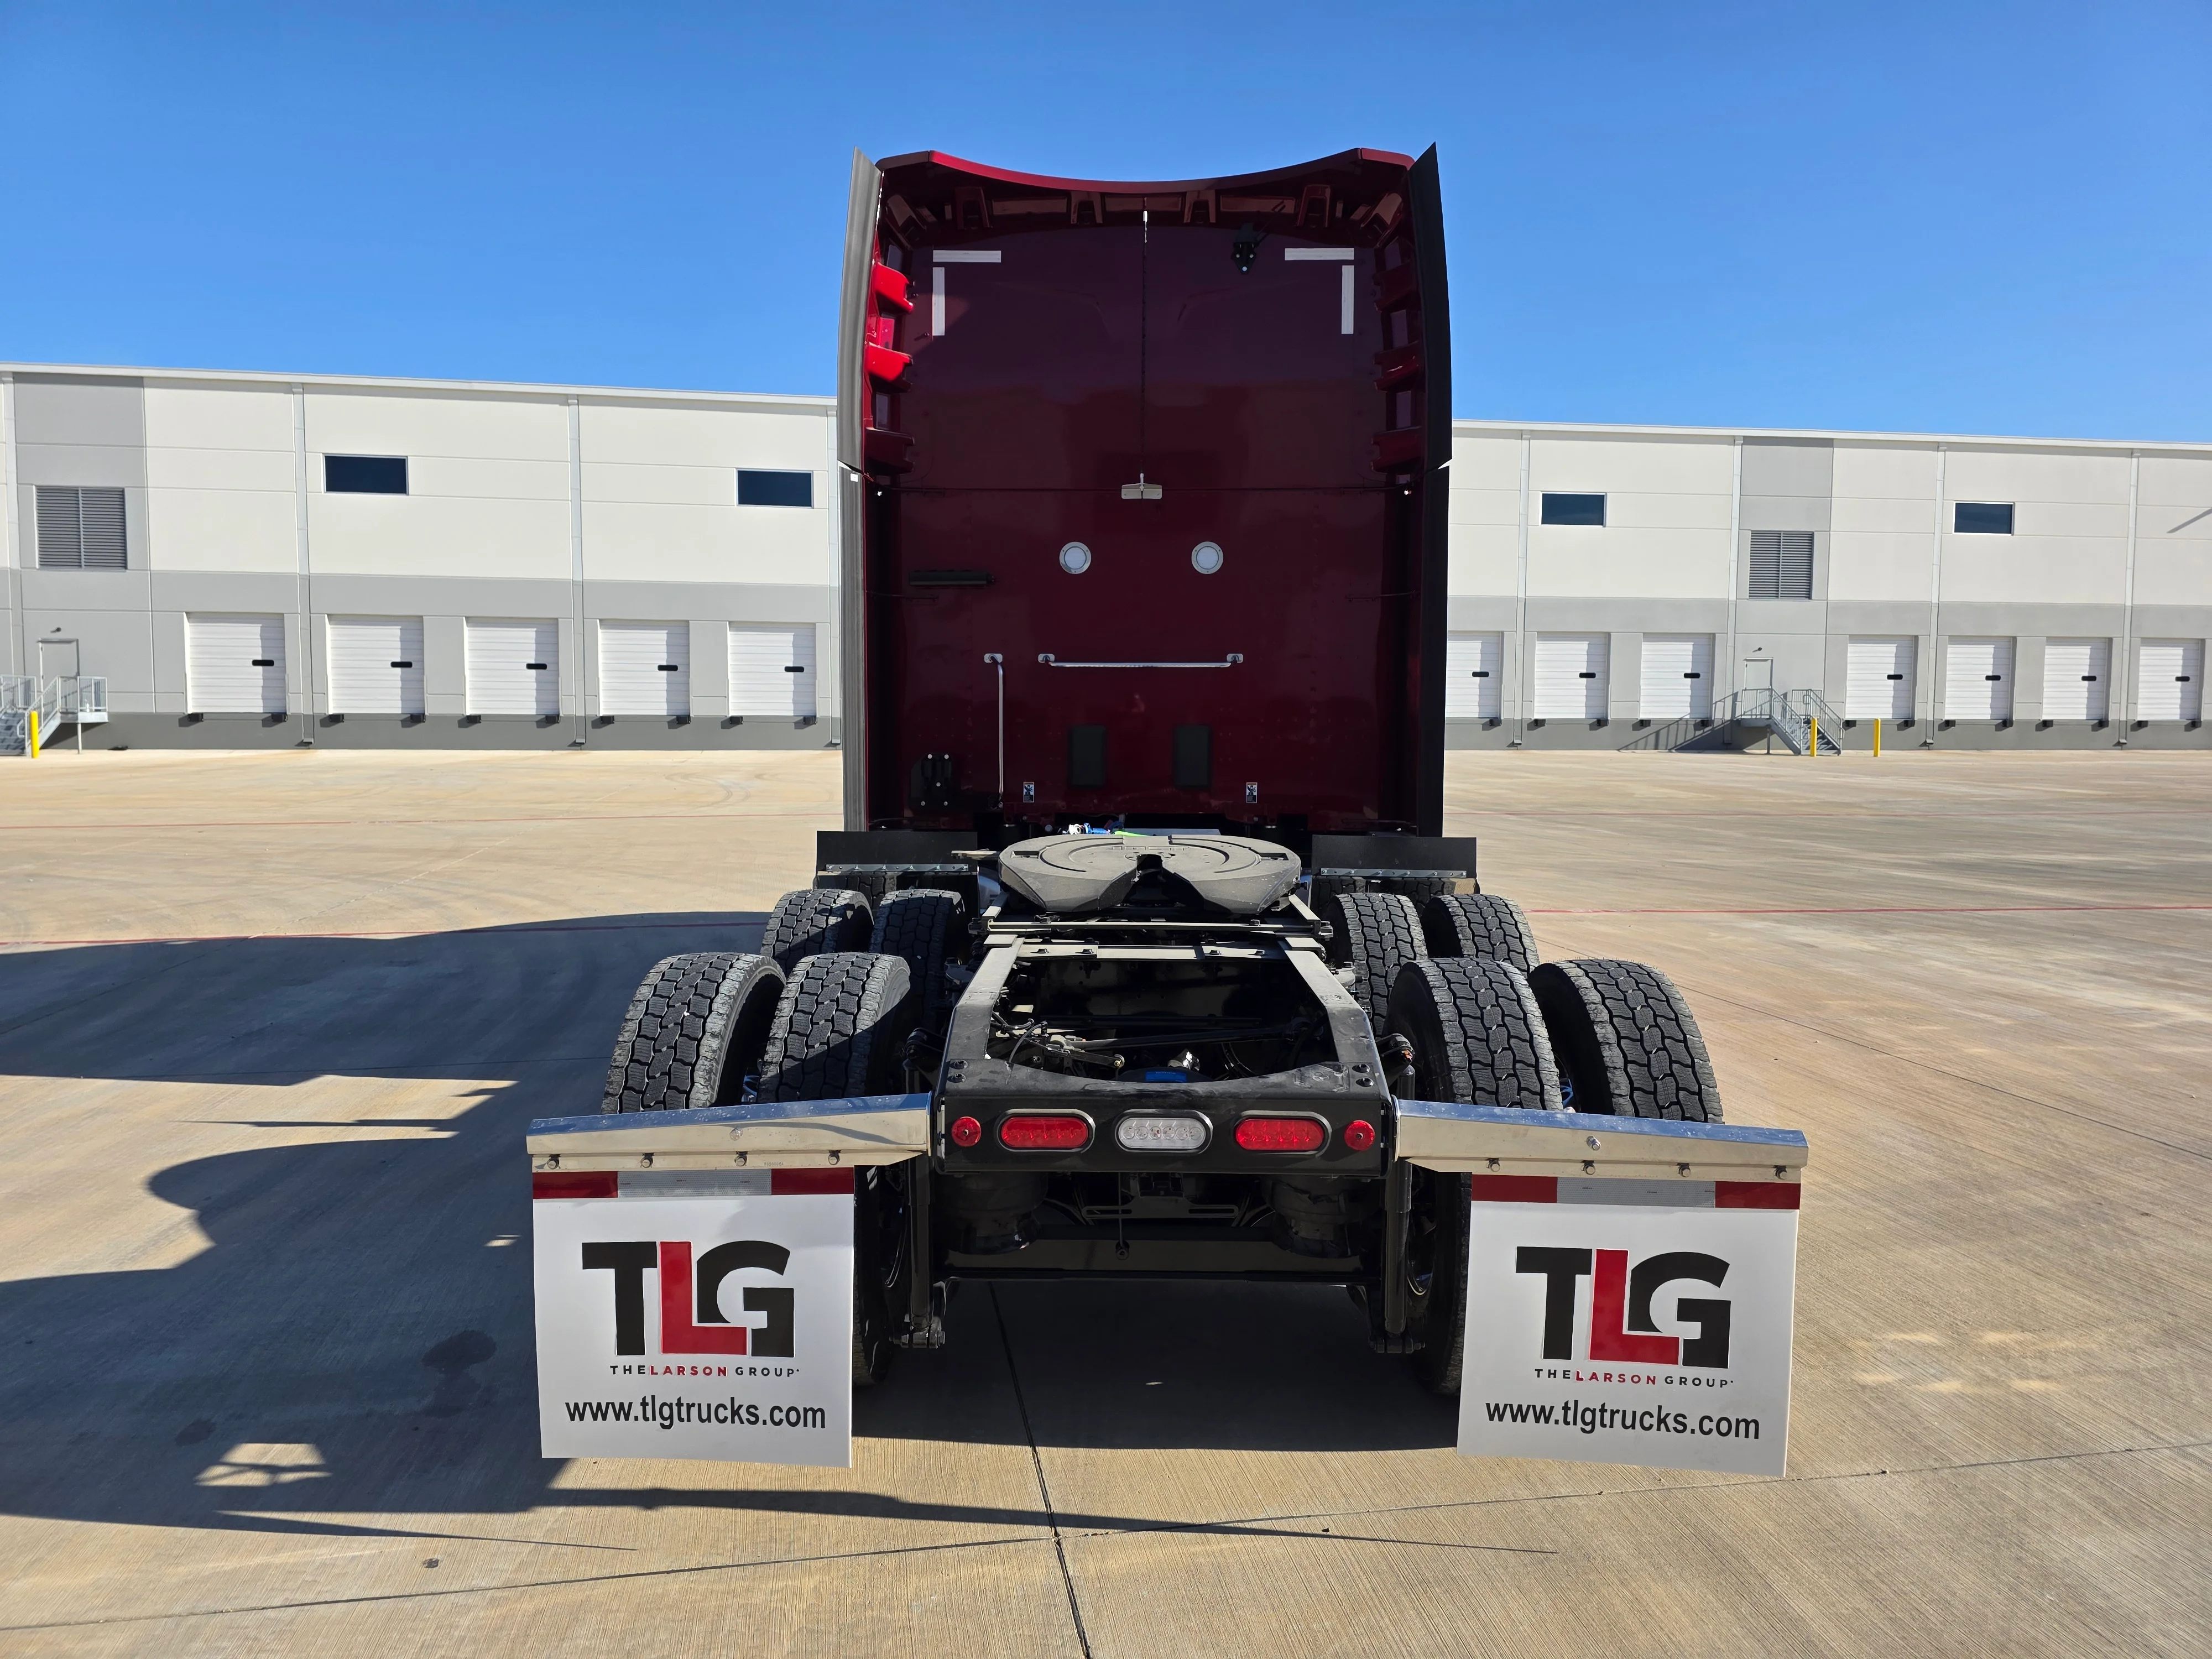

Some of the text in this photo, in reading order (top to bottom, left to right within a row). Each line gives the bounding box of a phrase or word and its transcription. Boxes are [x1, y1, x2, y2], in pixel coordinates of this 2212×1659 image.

[582, 1240, 795, 1358] TLG
[1515, 1246, 1732, 1369] TLG
[735, 1366, 794, 1377] GROUP
[1664, 1375, 1729, 1388] GROUP
[565, 1395, 826, 1430] www.tlgtrucks.com
[1485, 1400, 1760, 1439] www.tlgtrucks.com
